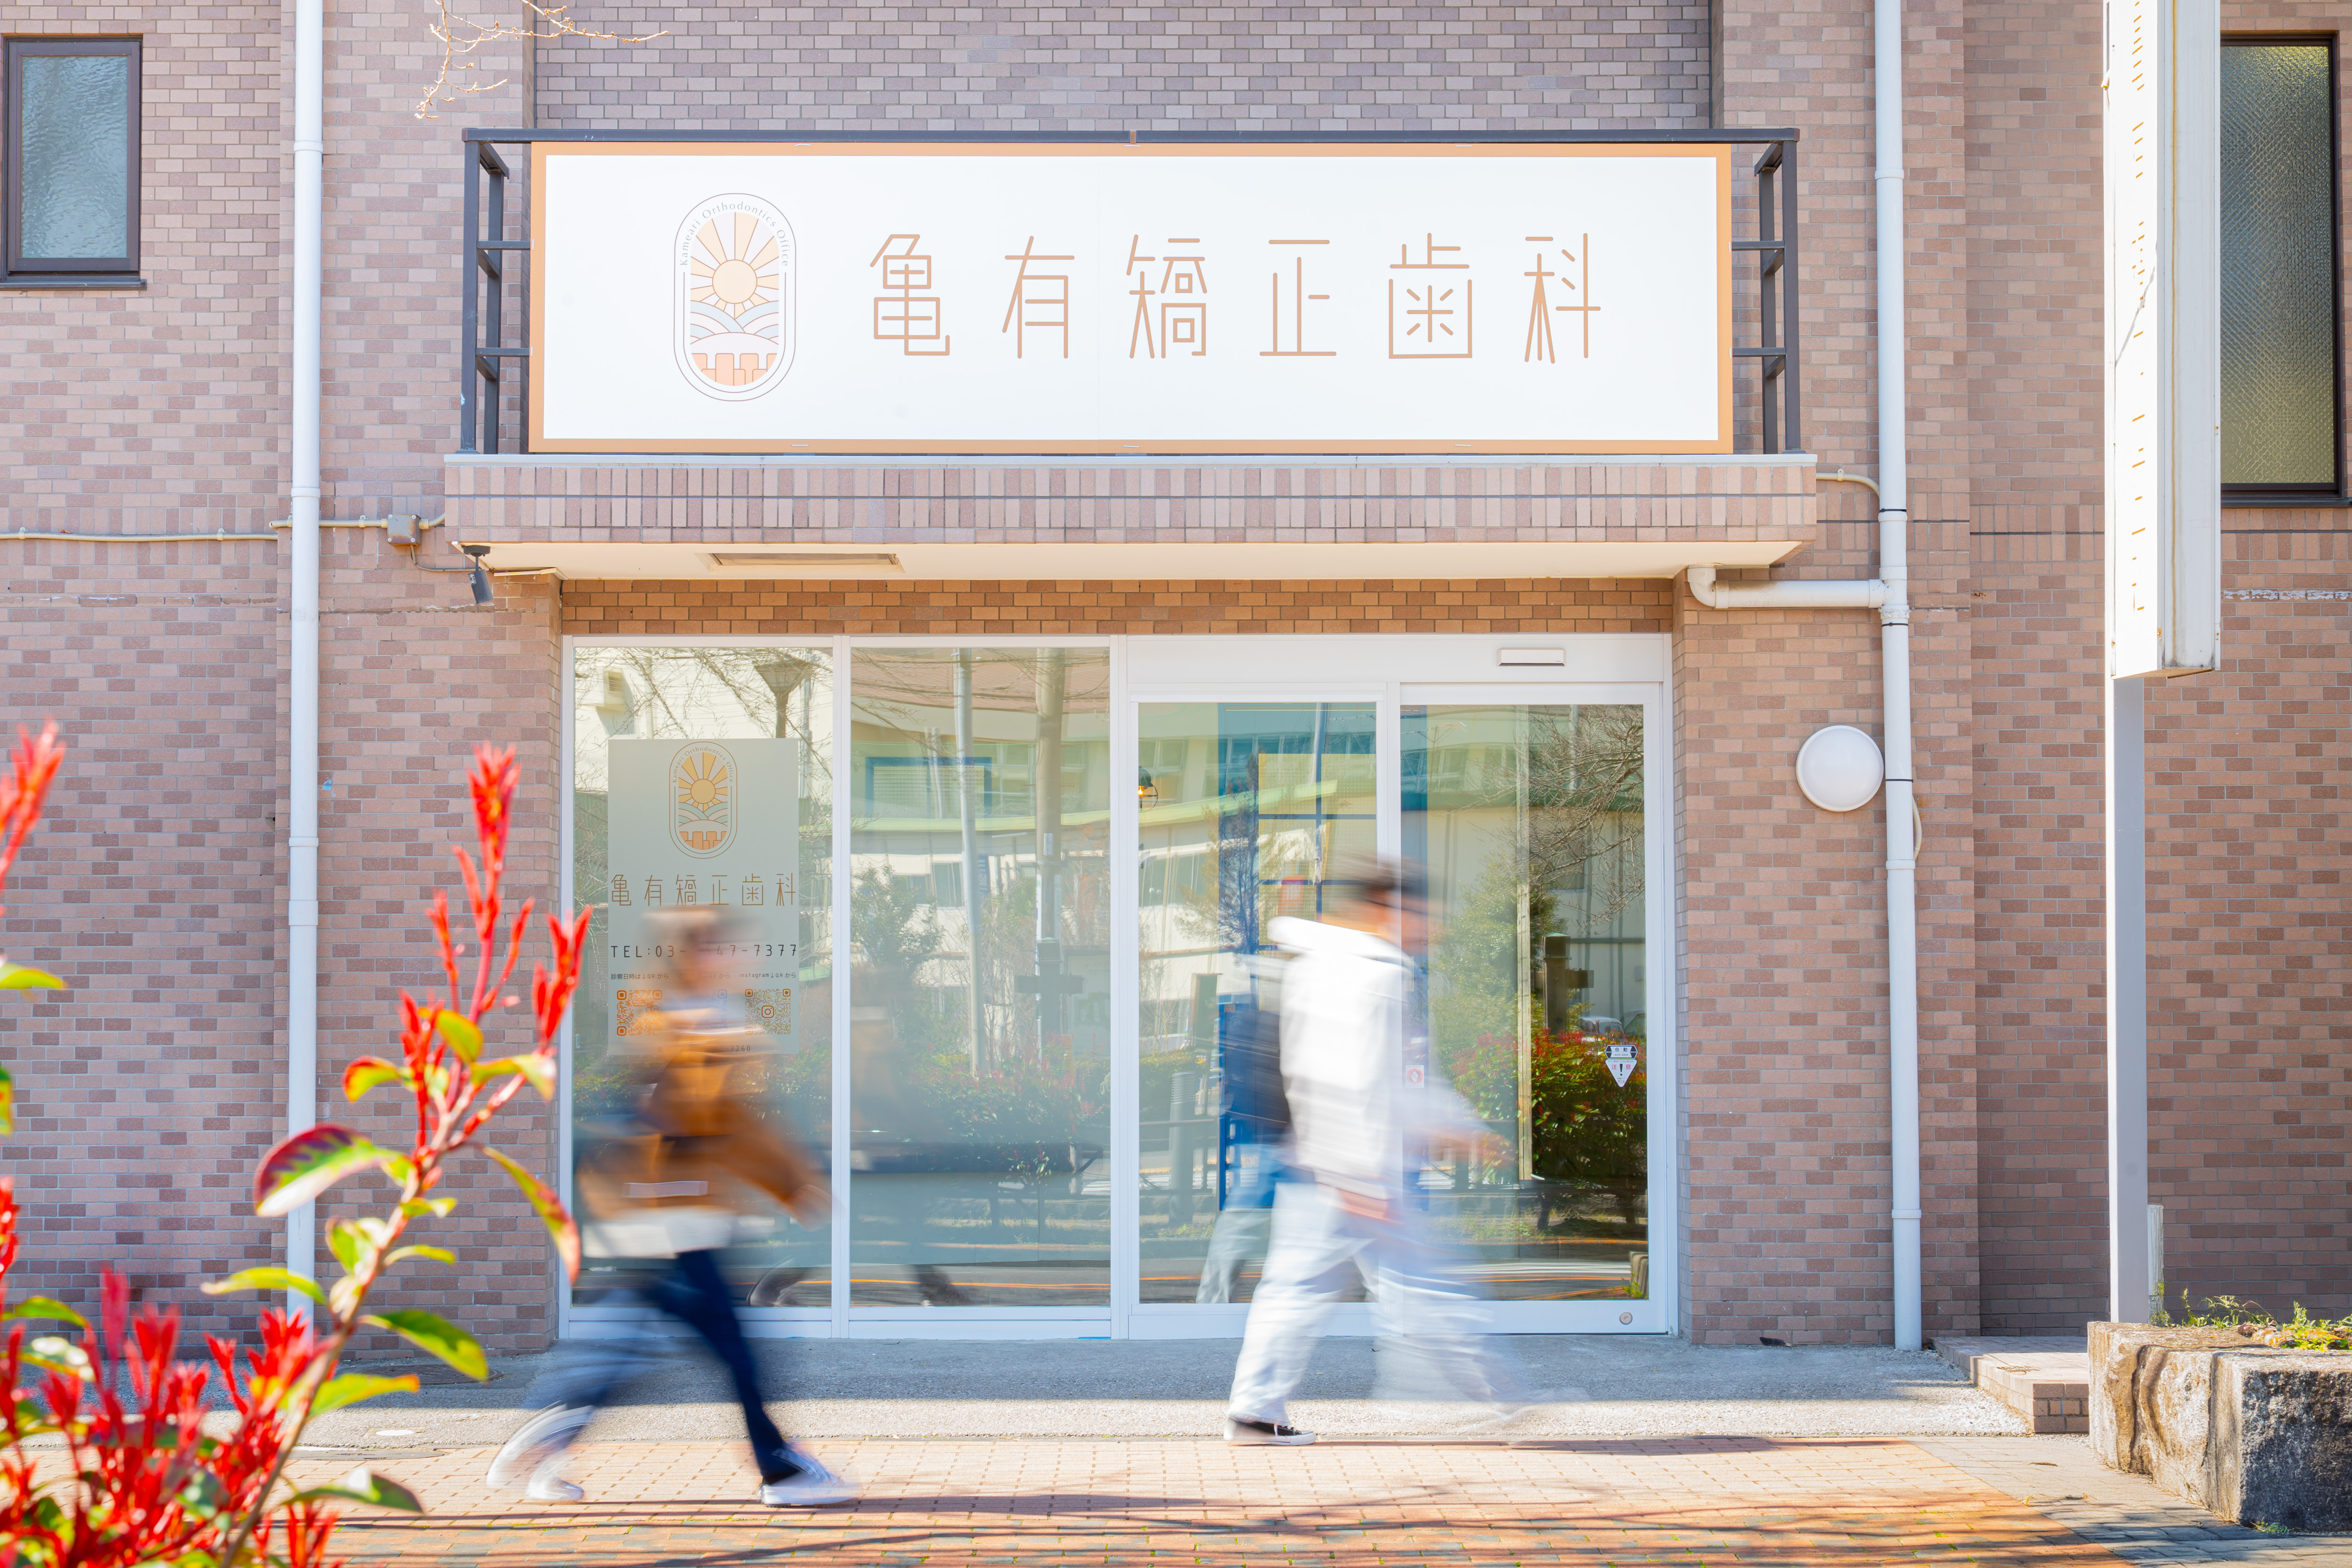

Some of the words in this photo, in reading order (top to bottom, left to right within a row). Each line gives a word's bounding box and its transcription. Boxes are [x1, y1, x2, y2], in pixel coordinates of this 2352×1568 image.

[680, 218, 701, 266] Kameari
[702, 201, 776, 227] Orthodontics
[776, 230, 790, 266] Office
[869, 234, 1601, 364] 亀有矯正歯科
[672, 756, 684, 783] Kameari
[684, 746, 726, 761] Orthodontics
[726, 762, 734, 783] Office
[611, 873, 796, 906] 亀有矯正歯科
